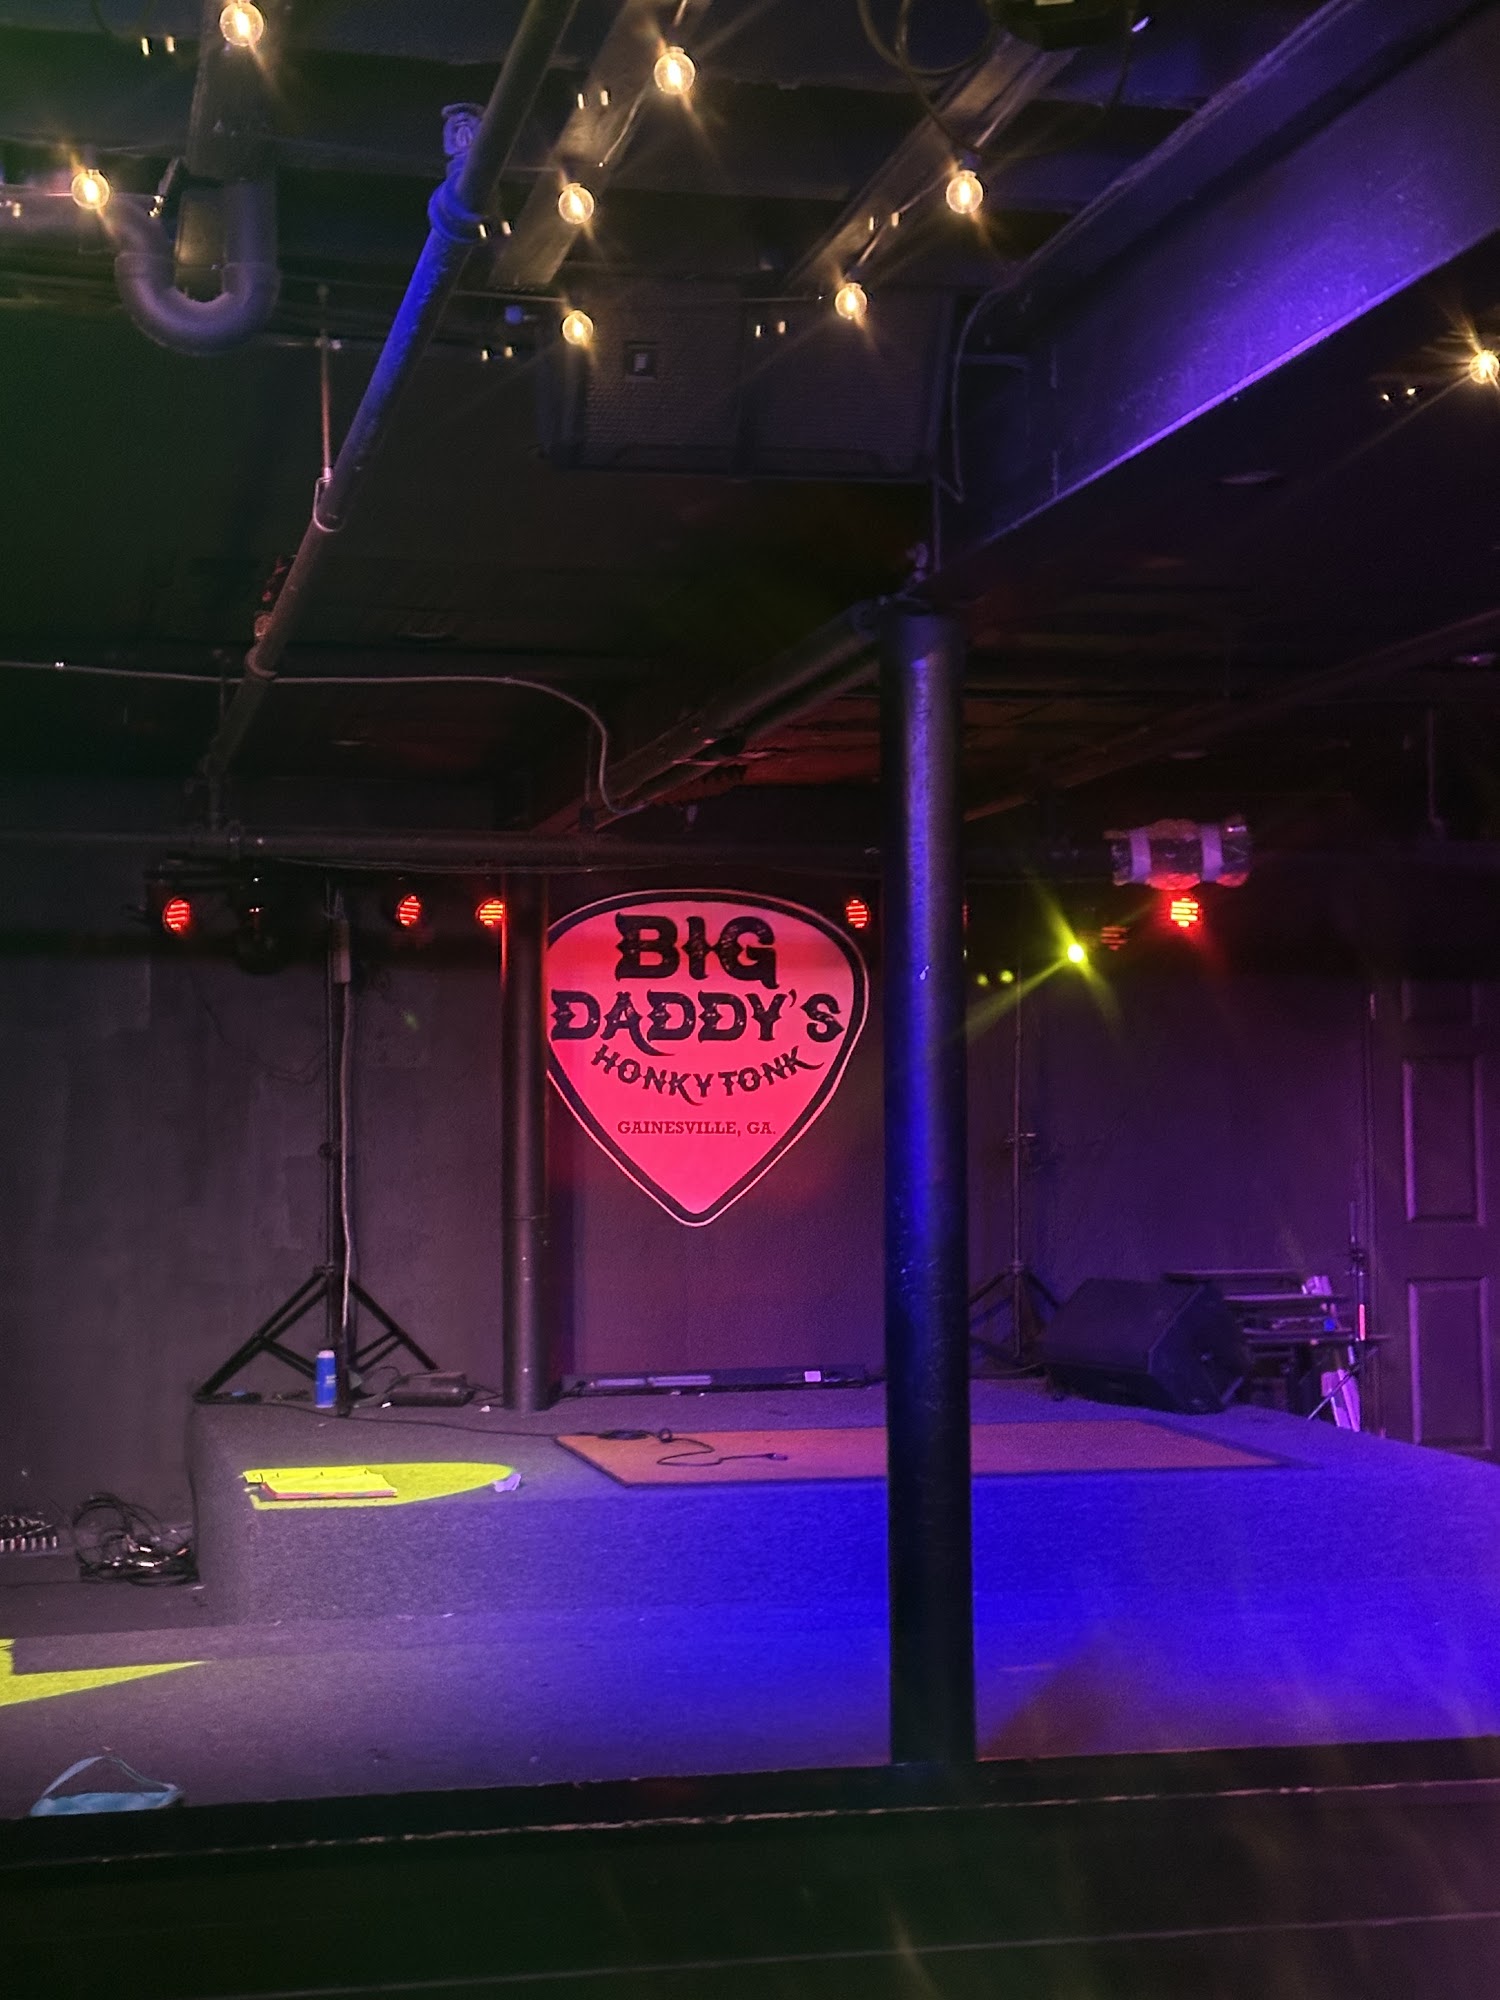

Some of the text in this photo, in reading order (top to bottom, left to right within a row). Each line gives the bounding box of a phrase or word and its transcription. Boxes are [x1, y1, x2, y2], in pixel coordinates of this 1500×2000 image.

[615, 912, 779, 989] BIG
[551, 988, 845, 1056] DADDY'S
[617, 1121, 776, 1137] GAINESVILLE, GA.
